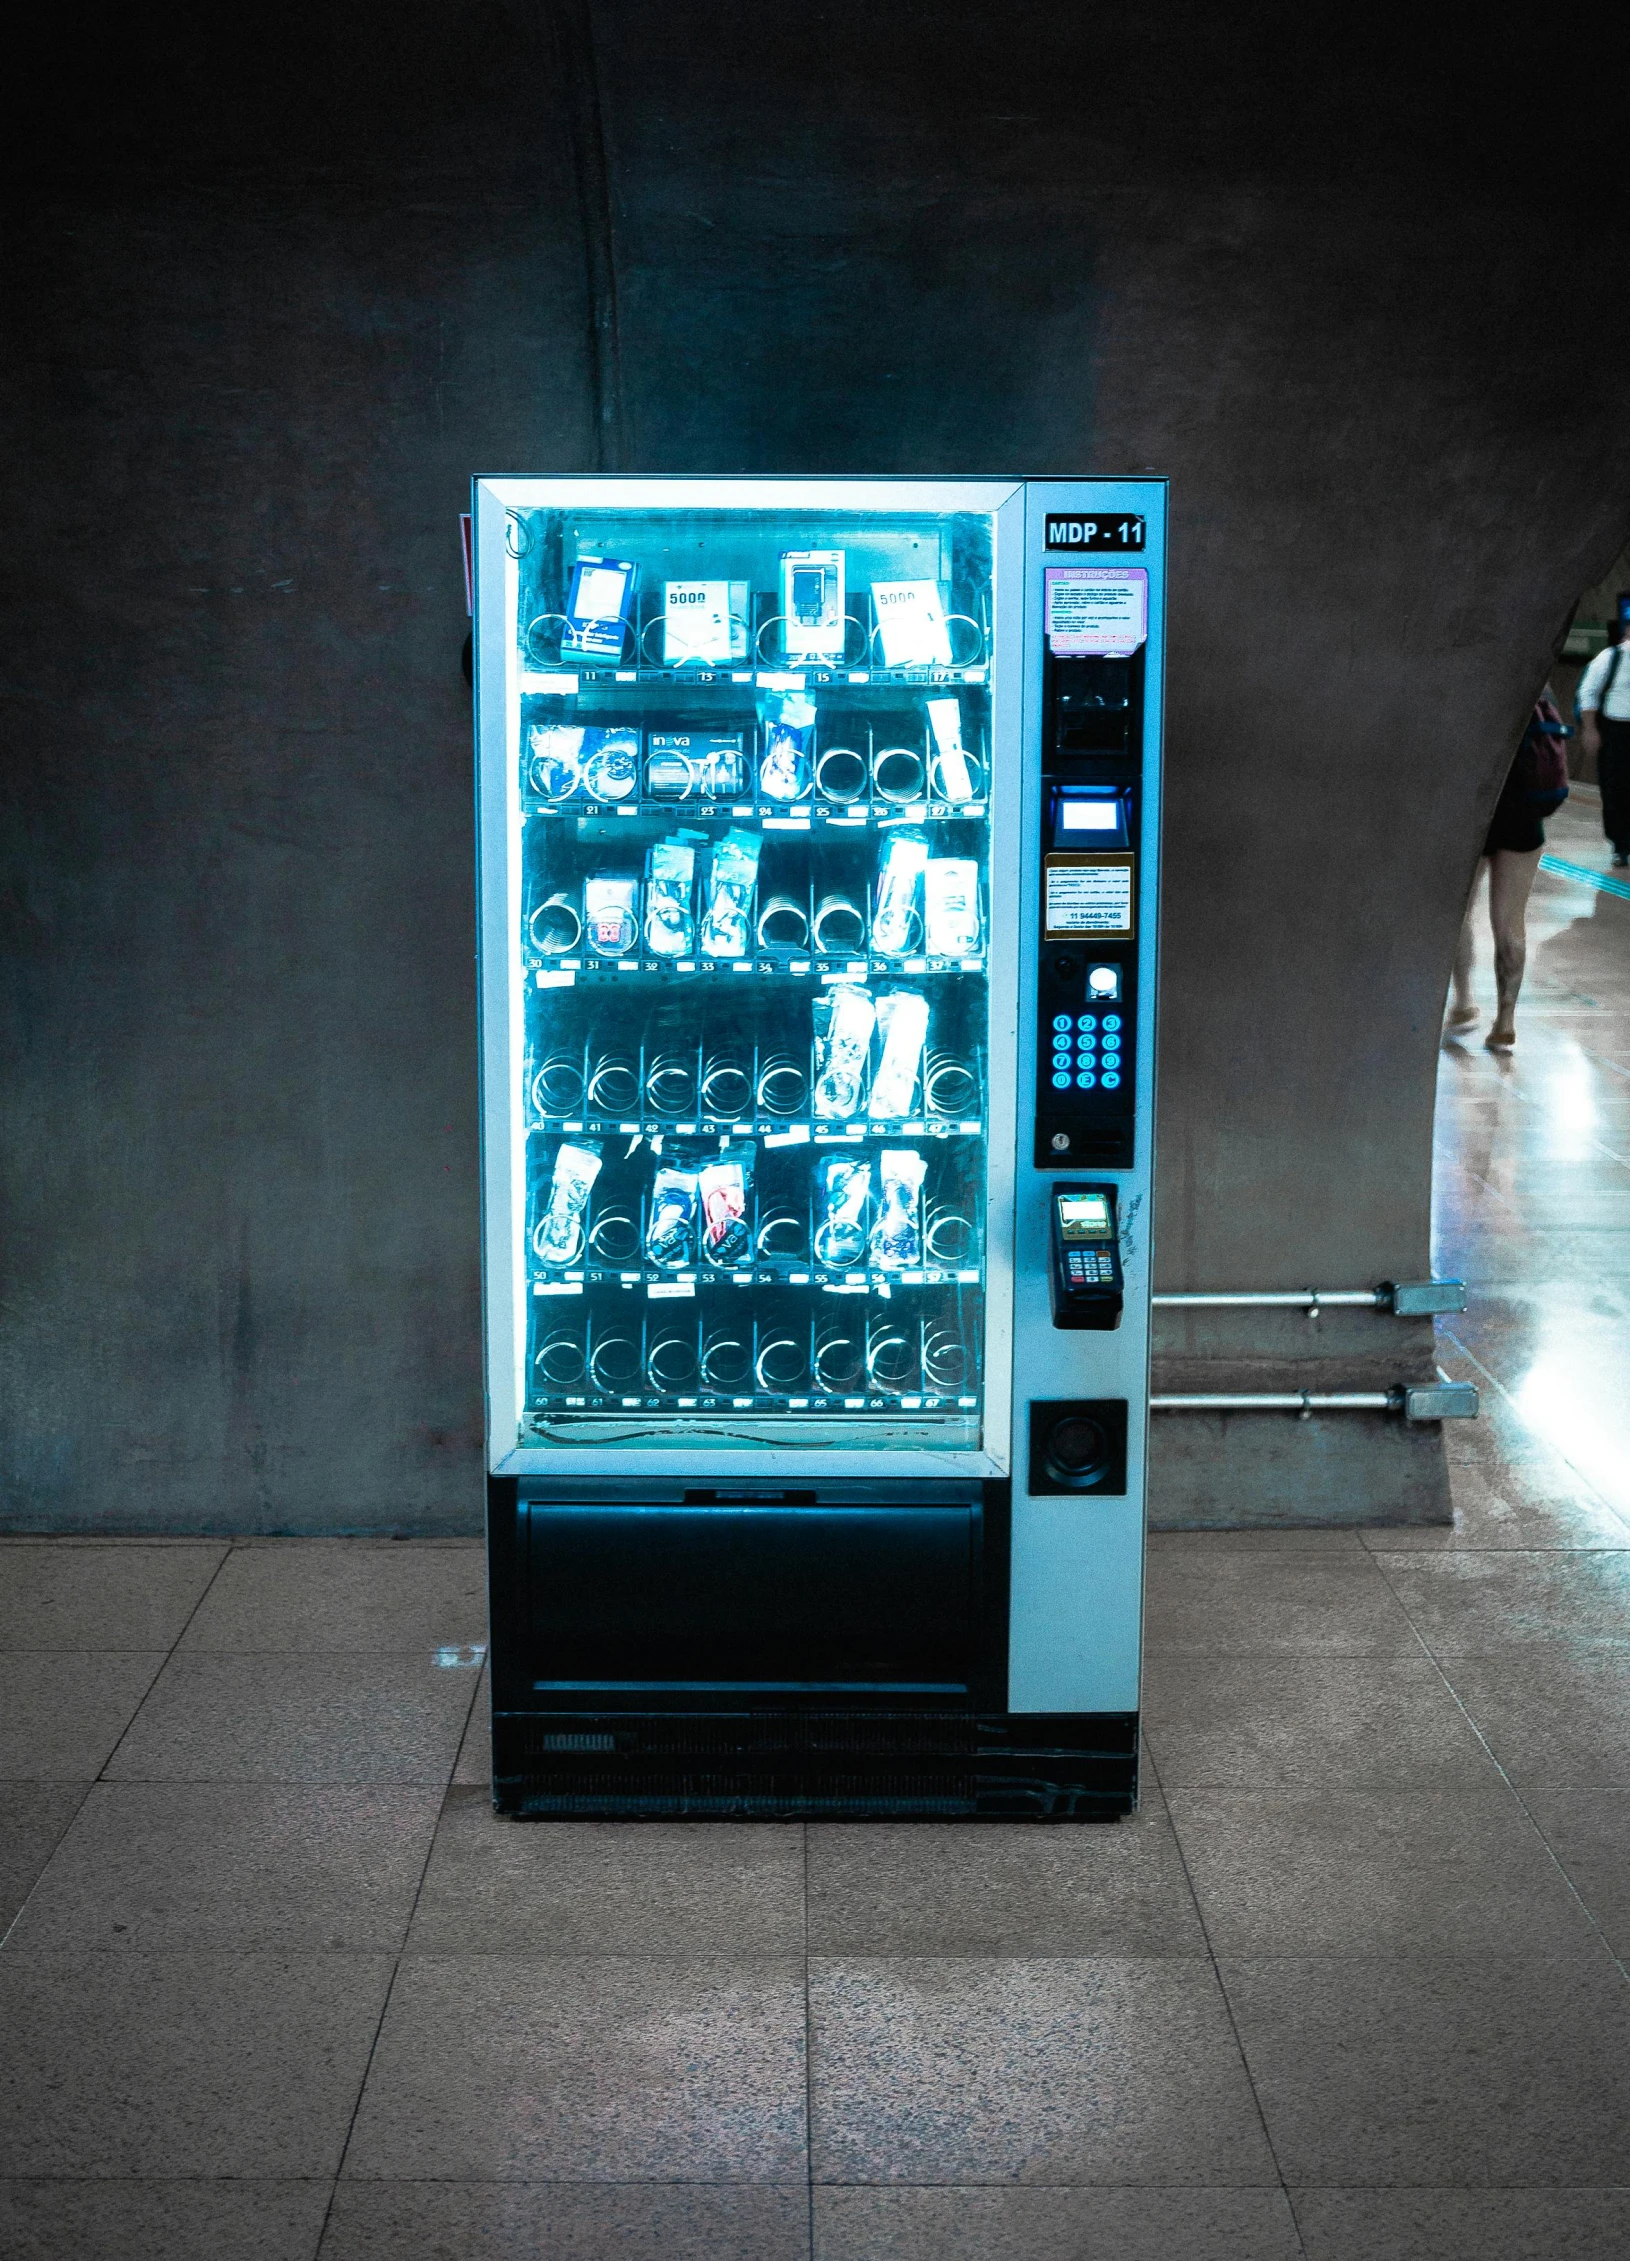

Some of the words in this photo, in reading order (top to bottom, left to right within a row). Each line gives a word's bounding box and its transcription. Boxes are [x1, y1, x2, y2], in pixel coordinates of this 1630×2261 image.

[1049, 522, 1097, 543] MDP
[1118, 522, 1142, 543] 11
[585, 671, 596, 681] 11
[816, 672, 829, 682] 15
[933, 672, 946, 682] 17
[585, 806, 598, 815] 21
[700, 806, 714, 816] 23
[816, 807, 830, 816] 25
[873, 807, 888, 816] 26
[931, 806, 945, 816] 27
[587, 961, 599, 969] 31
[645, 962, 658, 971] 32
[701, 962, 715, 971] 33
[816, 962, 829, 972] 35
[873, 962, 887, 971] 36
[589, 1123, 601, 1132] 41
[645, 1124, 658, 1133] 42
[702, 1125, 715, 1133] 43
[757, 1125, 772, 1133] 44
[815, 1125, 829, 1134] 45
[871, 1125, 886, 1134] 46
[533, 1271, 547, 1280] 50
[590, 1272, 602, 1281] 51
[646, 1273, 659, 1282] 52
[702, 1274, 715, 1282] 53
[758, 1274, 772, 1283] 54
[814, 1274, 828, 1283] 55
[871, 1273, 885, 1283] 56
[535, 1397, 548, 1406] 60
[592, 1398, 603, 1406] 61
[646, 1398, 660, 1407] 62
[702, 1398, 716, 1407] 63
[814, 1399, 827, 1407] 65
[870, 1399, 884, 1408] 66
[925, 1398, 939, 1407] 67
